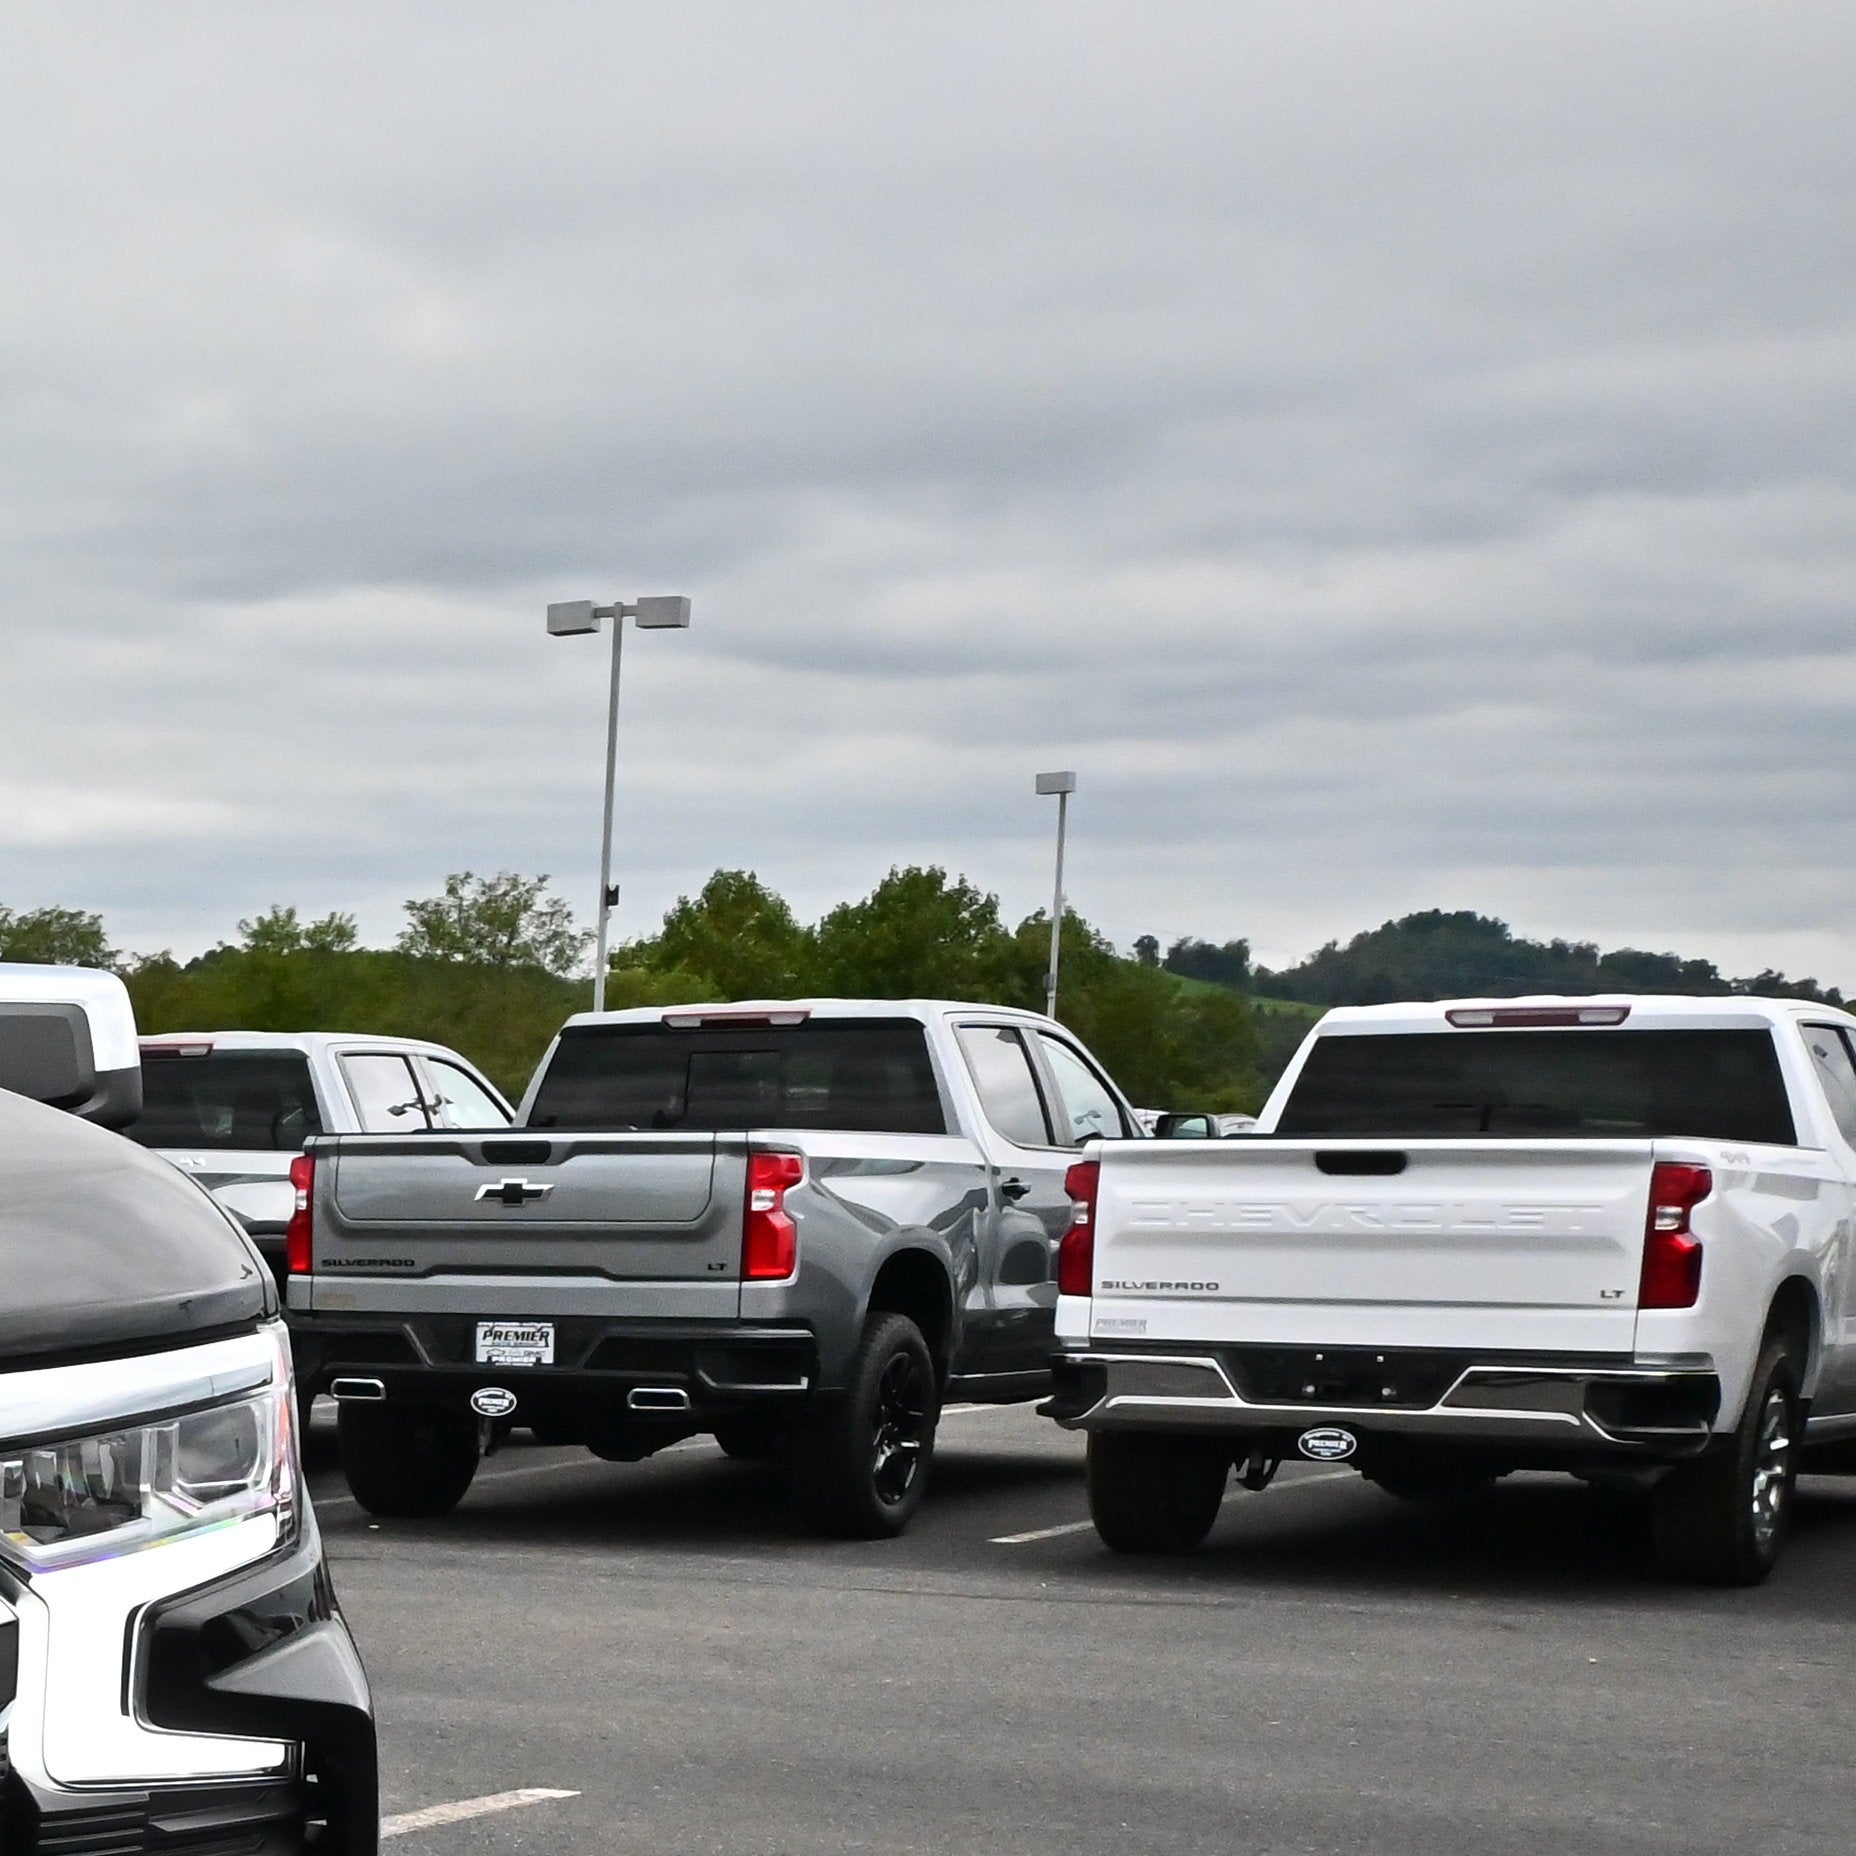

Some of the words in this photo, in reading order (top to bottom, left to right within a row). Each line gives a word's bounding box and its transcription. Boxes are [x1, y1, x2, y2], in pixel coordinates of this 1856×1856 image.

[1129, 1201, 1604, 1231] CHEVROLET
[321, 1259, 415, 1267] SILVERADO
[707, 1262, 728, 1271] LT
[1101, 1280, 1220, 1291] SILVERADO
[1600, 1289, 1626, 1299] LT
[482, 1329, 551, 1348] PREMIER
